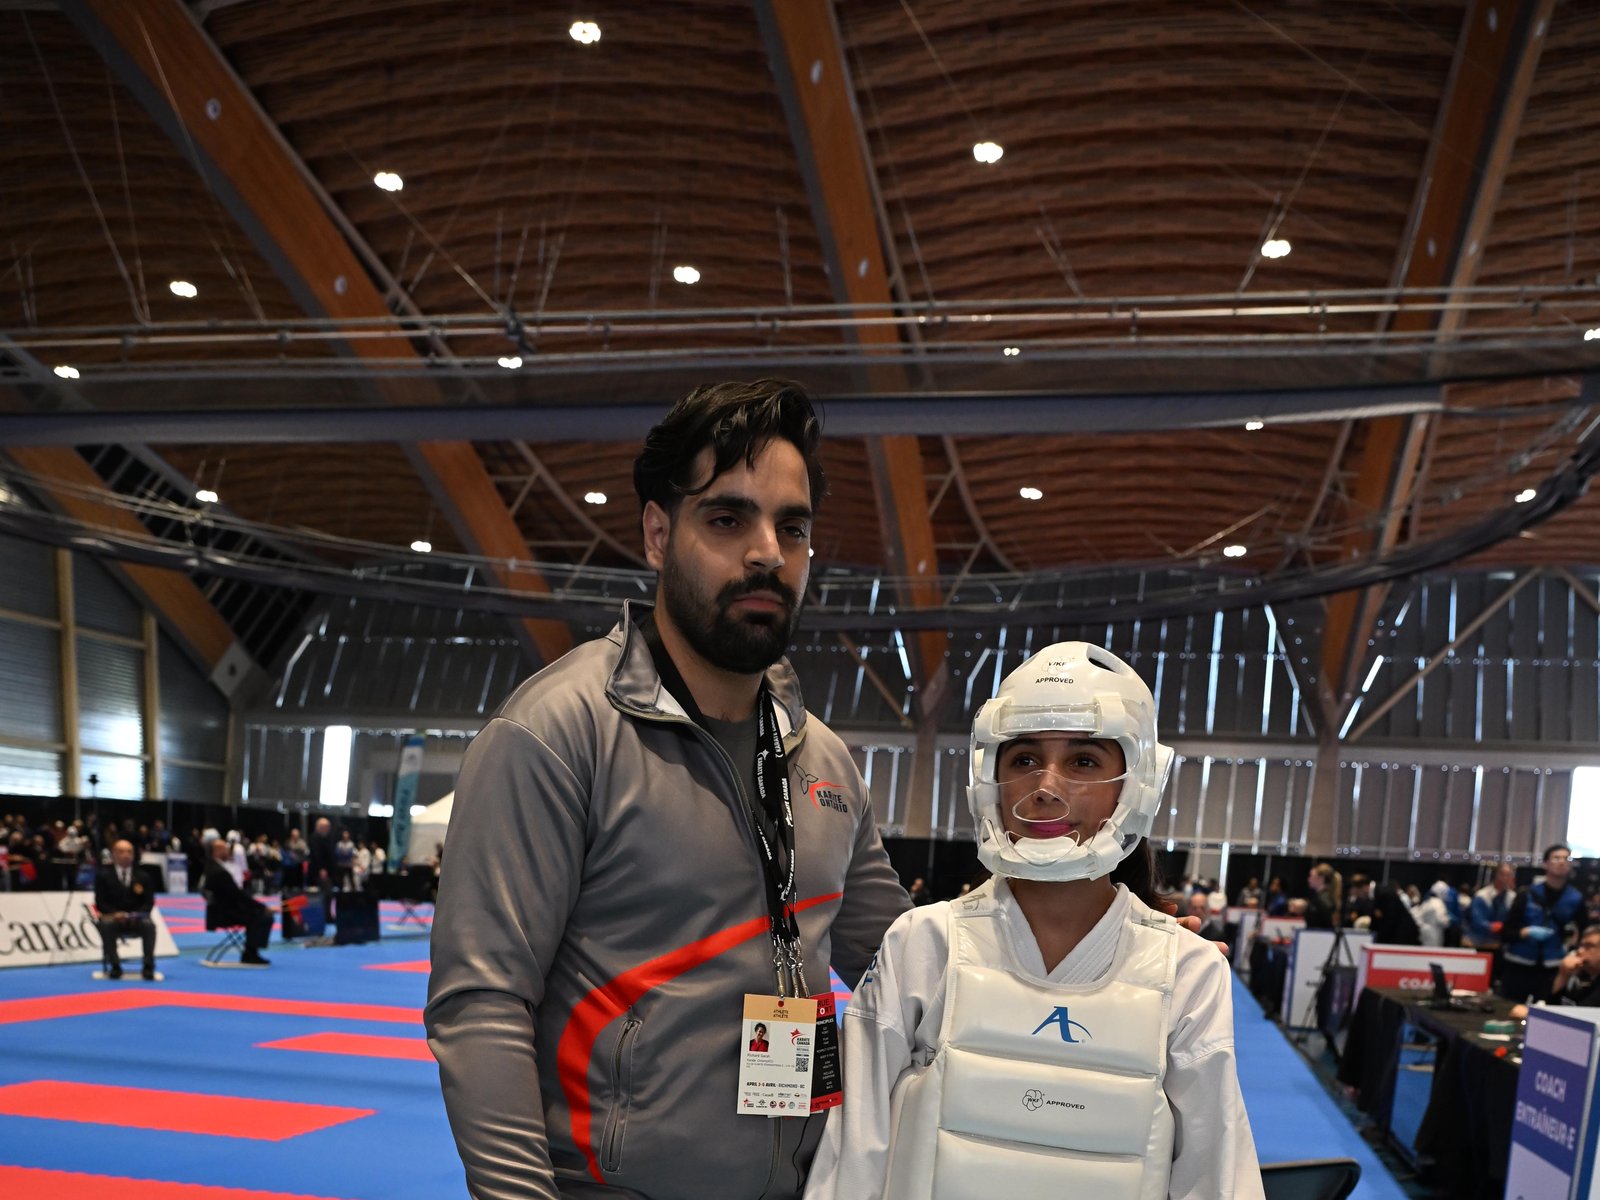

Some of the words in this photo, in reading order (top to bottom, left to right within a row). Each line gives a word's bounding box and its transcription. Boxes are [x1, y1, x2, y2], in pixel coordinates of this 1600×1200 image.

[1035, 676, 1074, 685] APPROVED
[772, 732, 782, 754] KARATE
[755, 757, 763, 776] KARATE
[757, 775, 767, 800] CANADA
[781, 777, 790, 801] CANADA
[1534, 1070, 1568, 1104] COACH
[1046, 1100, 1086, 1110] APPROVED
